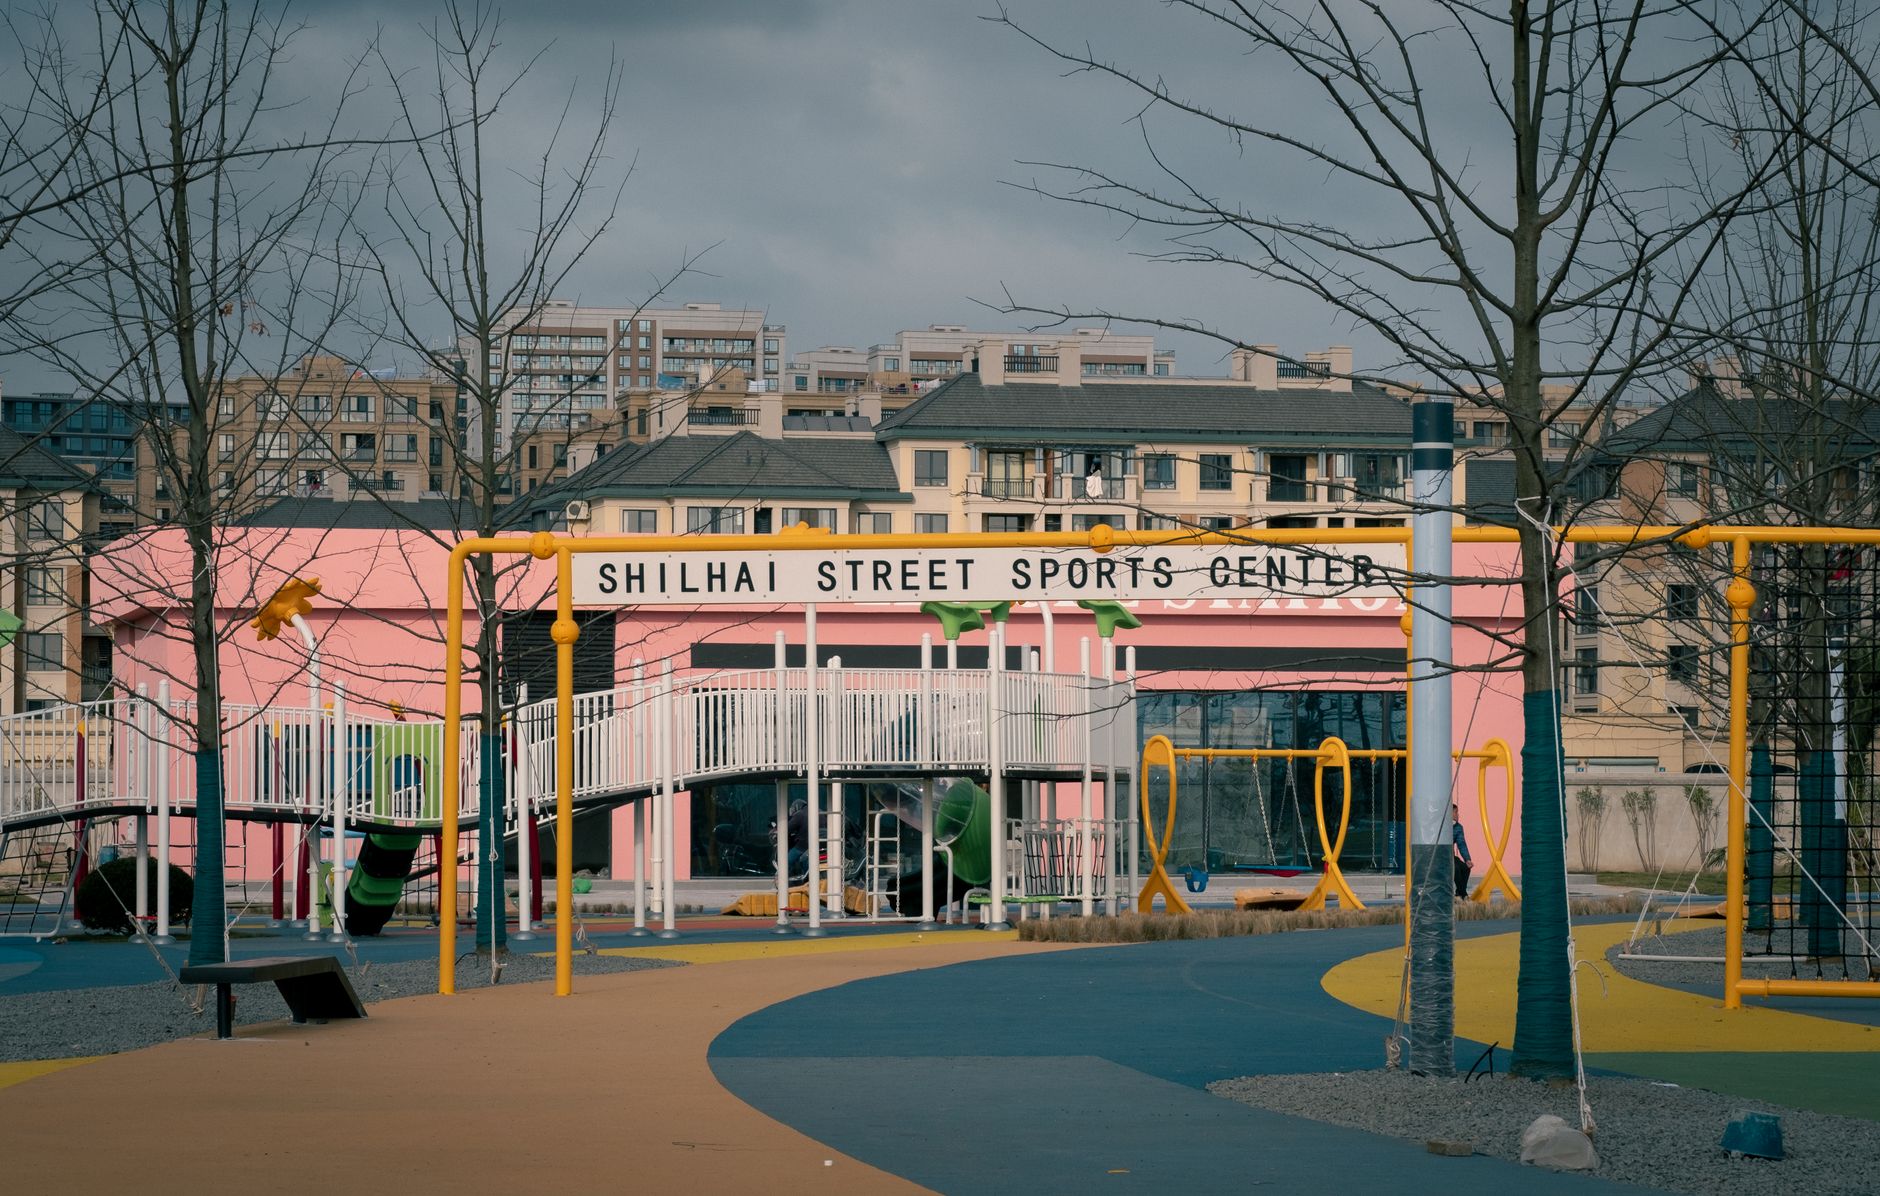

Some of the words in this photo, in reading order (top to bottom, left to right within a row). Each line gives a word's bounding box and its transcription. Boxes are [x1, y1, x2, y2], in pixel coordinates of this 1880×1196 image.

[599, 562, 775, 593] SHILHAI
[818, 560, 974, 591] STREET
[1012, 556, 1173, 589] SPORTS
[1210, 554, 1374, 588] CENTER
